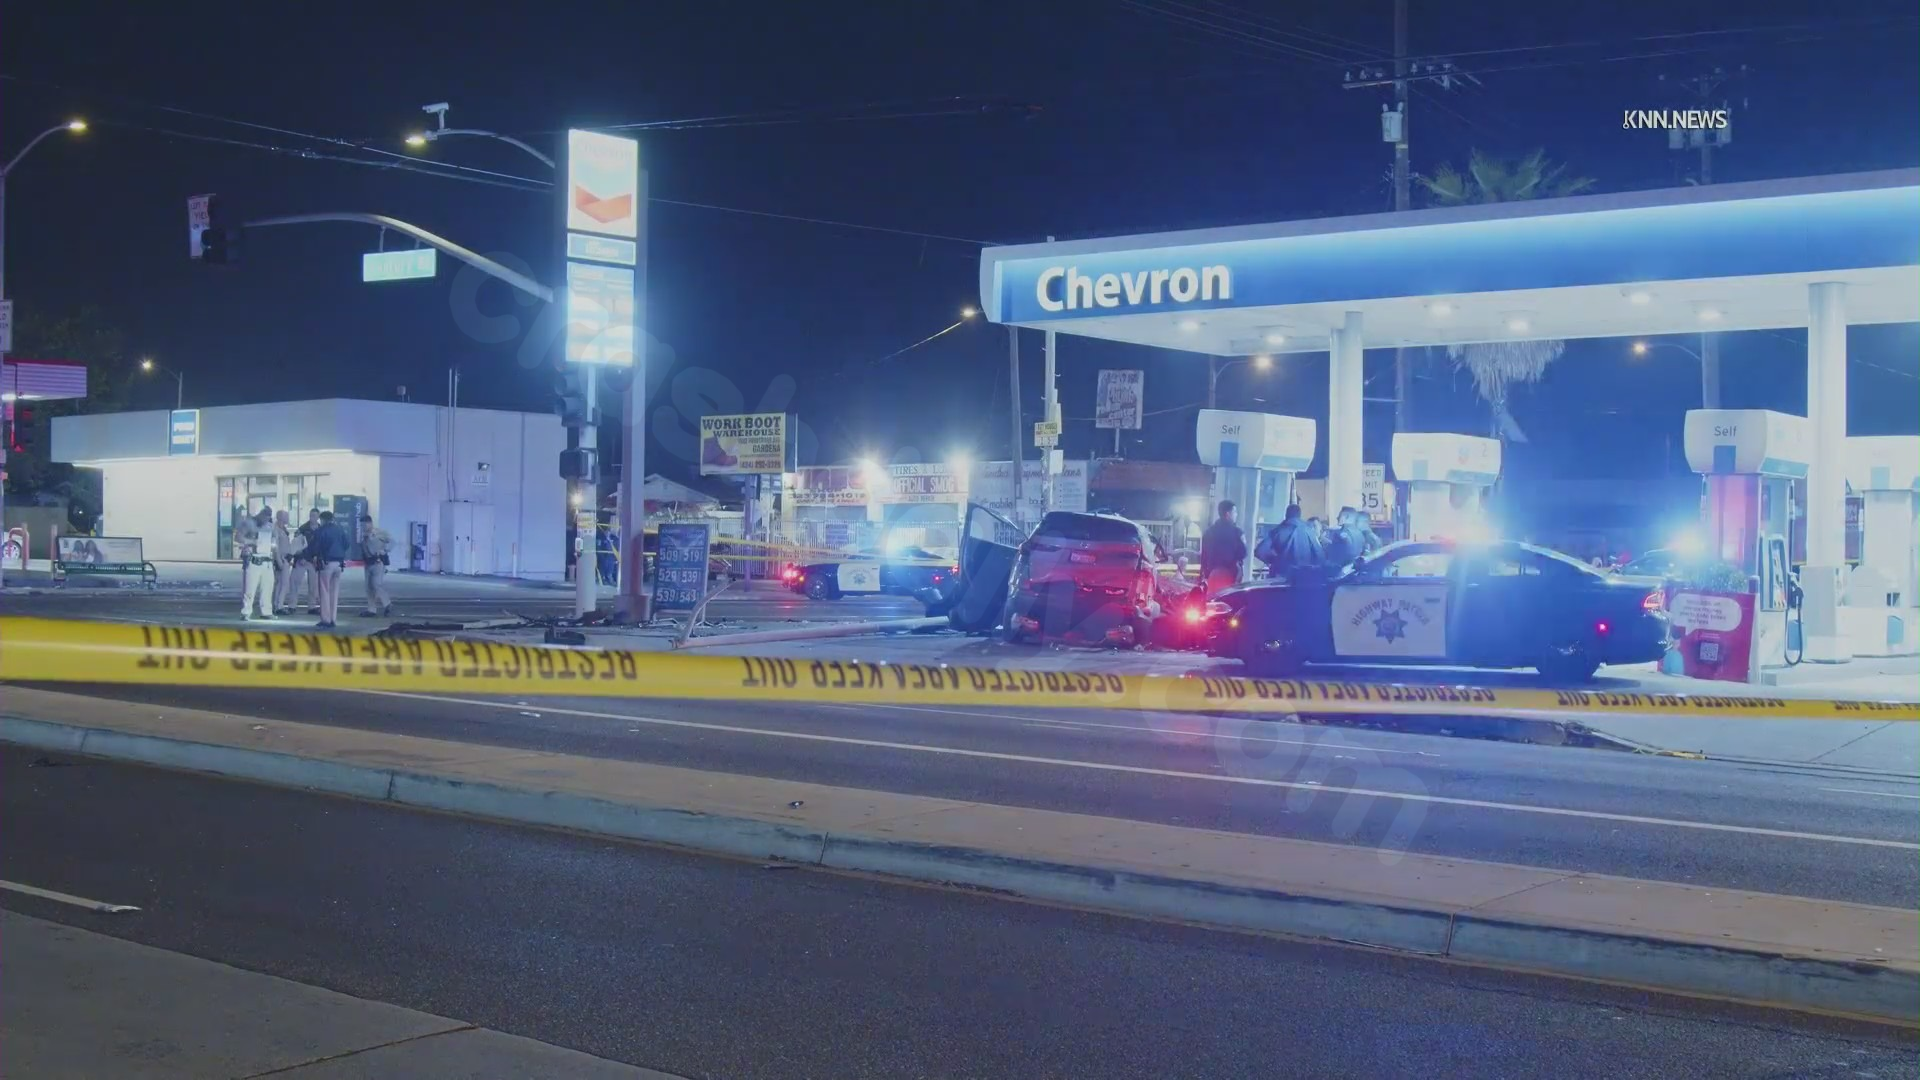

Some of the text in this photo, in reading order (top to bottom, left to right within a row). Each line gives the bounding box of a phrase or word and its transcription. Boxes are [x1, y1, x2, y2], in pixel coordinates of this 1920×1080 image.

[1037, 265, 1231, 312] Chevron
[703, 416, 781, 431] WORK BOOT
[1221, 425, 1240, 434] Self
[713, 428, 781, 437] WAREHOUSE
[1714, 426, 1737, 436] Self
[752, 444, 780, 453] GARDENA
[895, 465, 918, 475] TIRES
[894, 477, 955, 493] OFFICIAL SMOG
[1351, 598, 1393, 626] HIGHWAY
[138, 625, 638, 681] RESTRICTED AREA KEEP OUT
